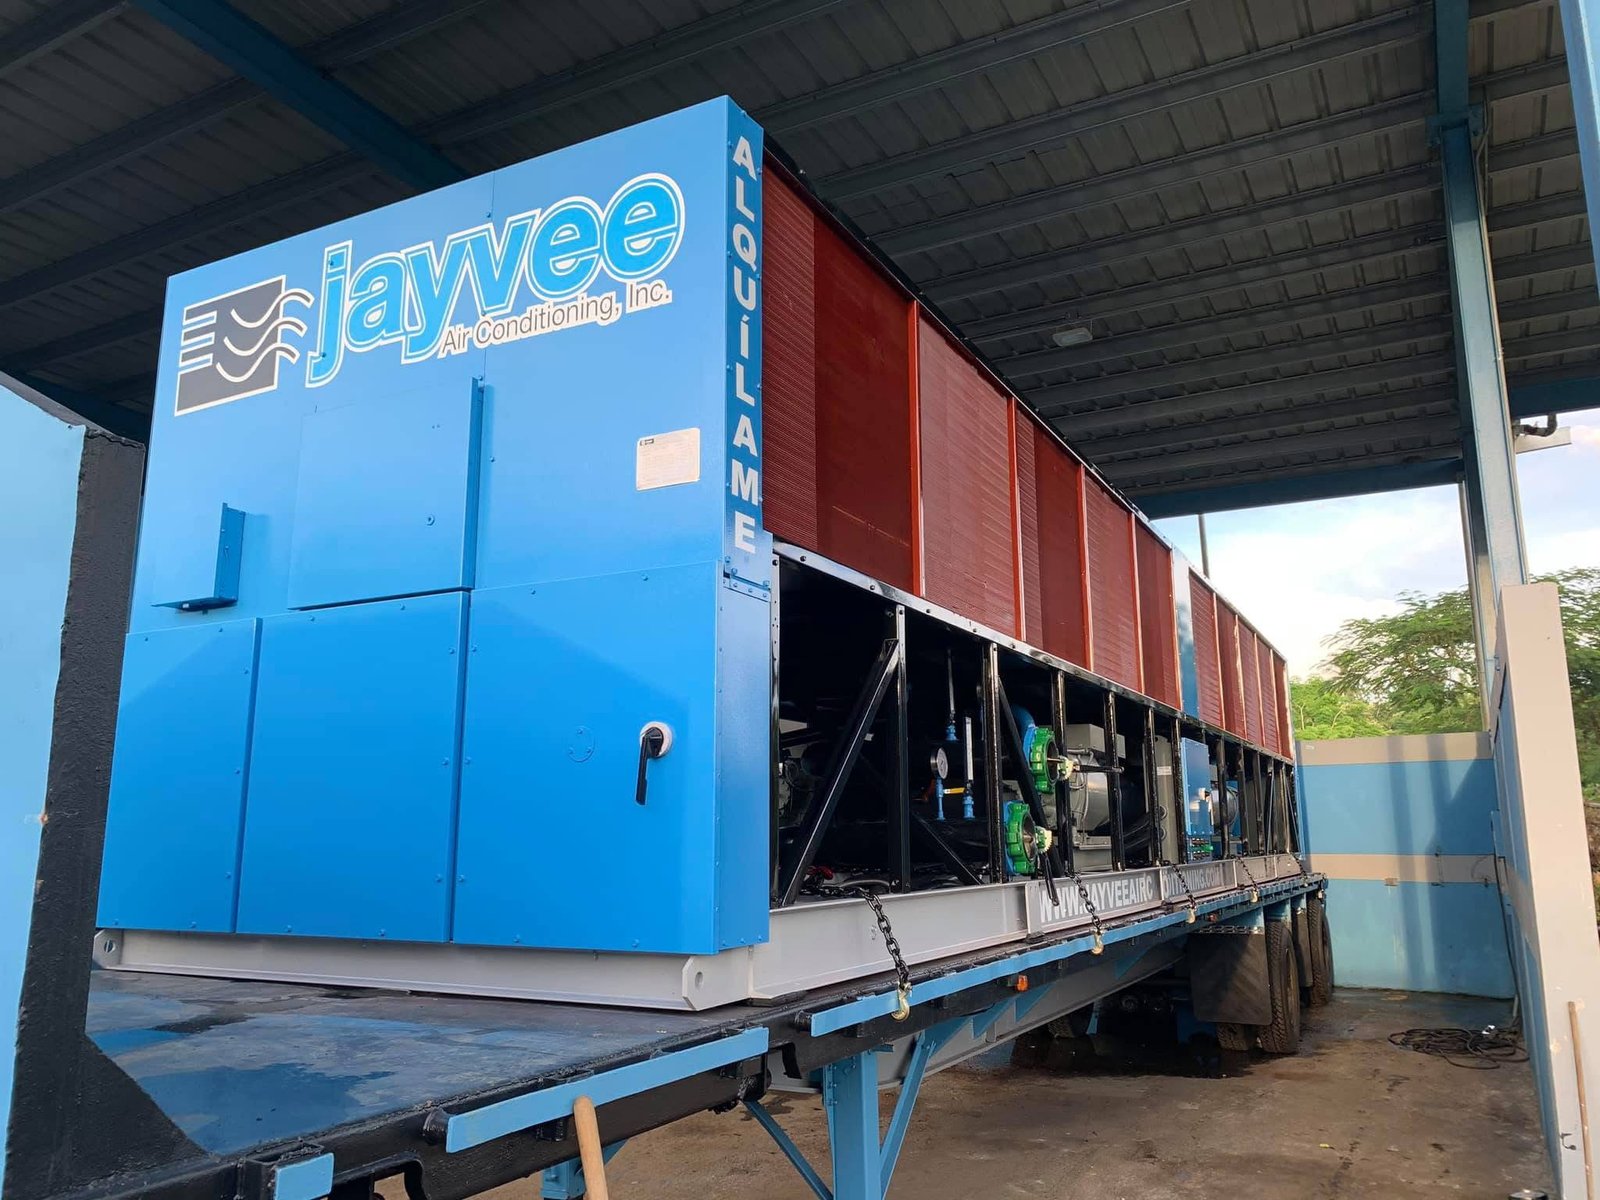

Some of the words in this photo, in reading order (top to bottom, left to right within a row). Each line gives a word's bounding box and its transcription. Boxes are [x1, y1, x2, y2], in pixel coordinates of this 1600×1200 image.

[305, 172, 685, 388] jayvee
[441, 327, 470, 354] Air
[475, 294, 620, 345] Conditioning,
[629, 282, 670, 308] Inc.
[731, 135, 759, 553] ALQUÍLAME
